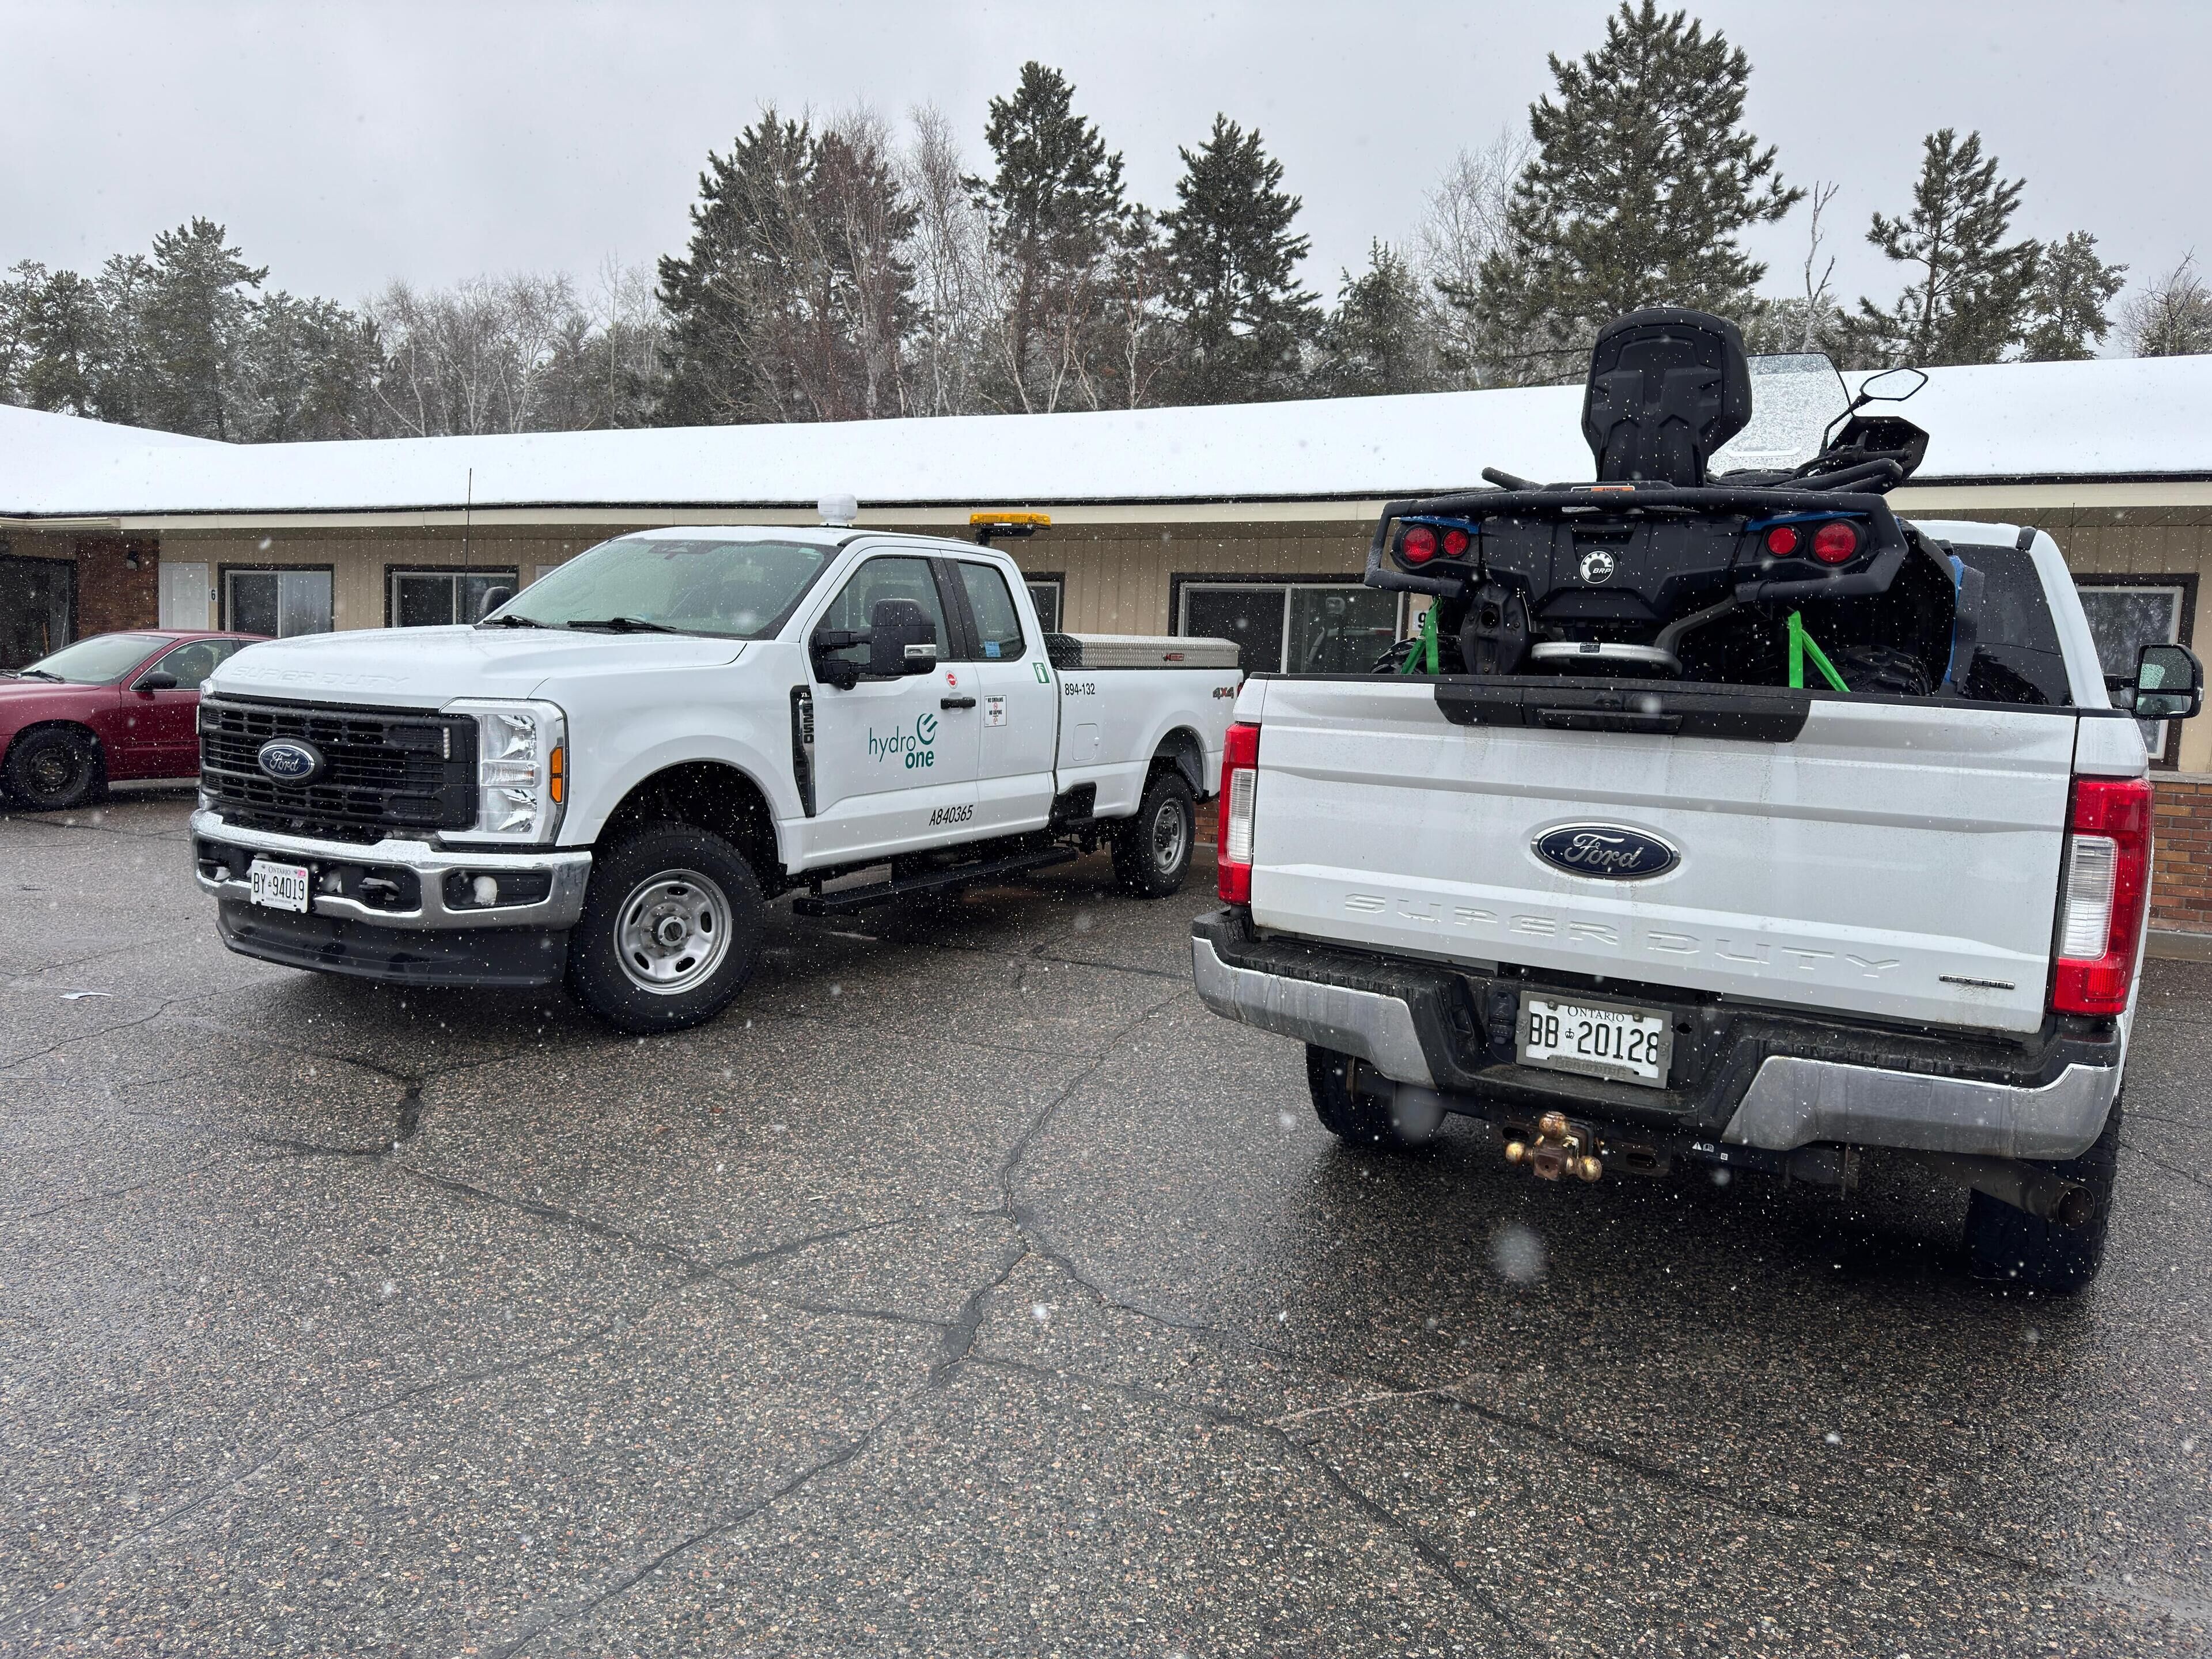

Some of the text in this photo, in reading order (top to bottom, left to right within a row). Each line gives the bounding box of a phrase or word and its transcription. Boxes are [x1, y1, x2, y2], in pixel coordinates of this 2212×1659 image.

[211, 589, 215, 600] 6
[1418, 612, 1427, 628] 9
[231, 666, 410, 688] SUPER DUTY
[1065, 683, 1095, 695] 894-132
[869, 726, 916, 762] hydro
[270, 751, 299, 772] Ford
[905, 751, 934, 768] one
[929, 805, 974, 826] A840365
[1564, 834, 1644, 868] Ford
[253, 872, 304, 900] BY 94019
[1346, 893, 1900, 978] SUPER DUTY
[1943, 976, 2013, 989] FLEX FUEL
[1567, 1006, 1624, 1022] ONTARIO
[1529, 1013, 1660, 1065] BB 20128
